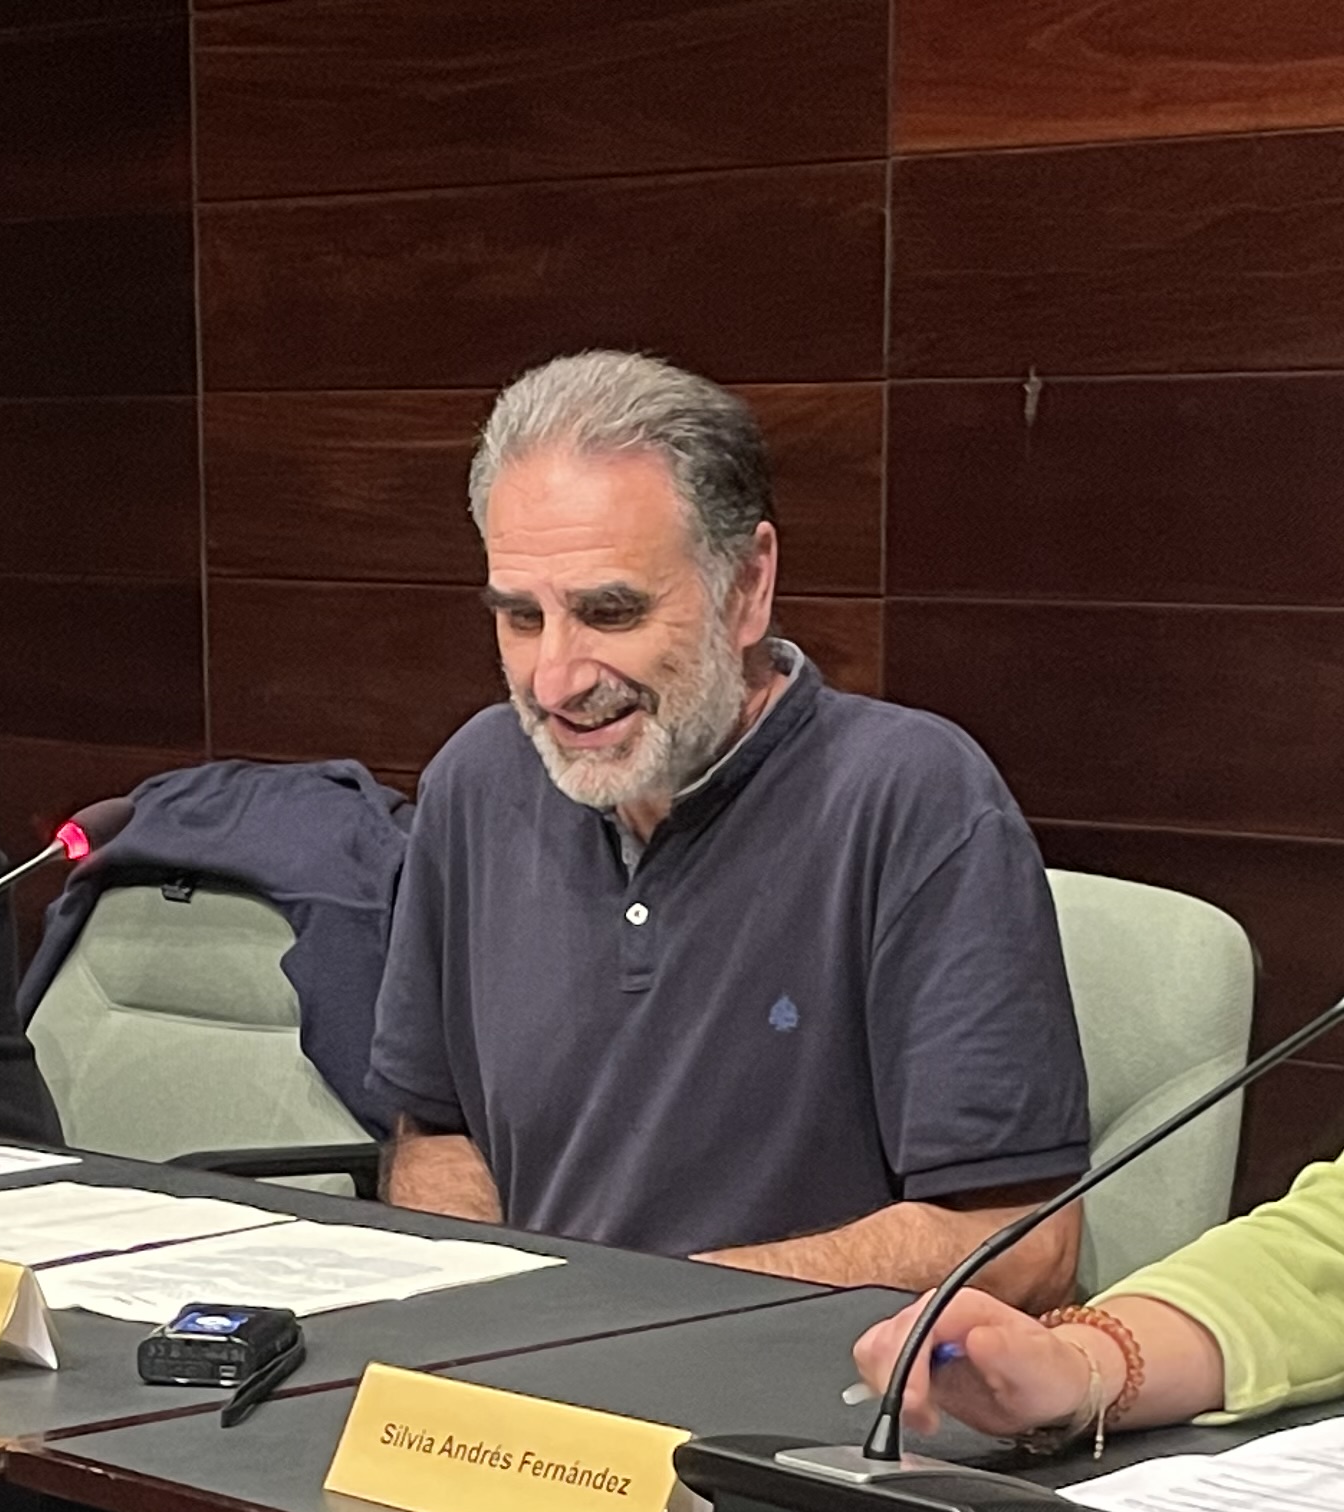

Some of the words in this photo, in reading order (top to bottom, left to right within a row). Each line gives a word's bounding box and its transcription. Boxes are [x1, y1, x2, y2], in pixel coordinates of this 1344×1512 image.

[380, 1423, 435, 1454] Silvia
[439, 1435, 513, 1471] Andrés
[518, 1451, 632, 1495] Fernández
